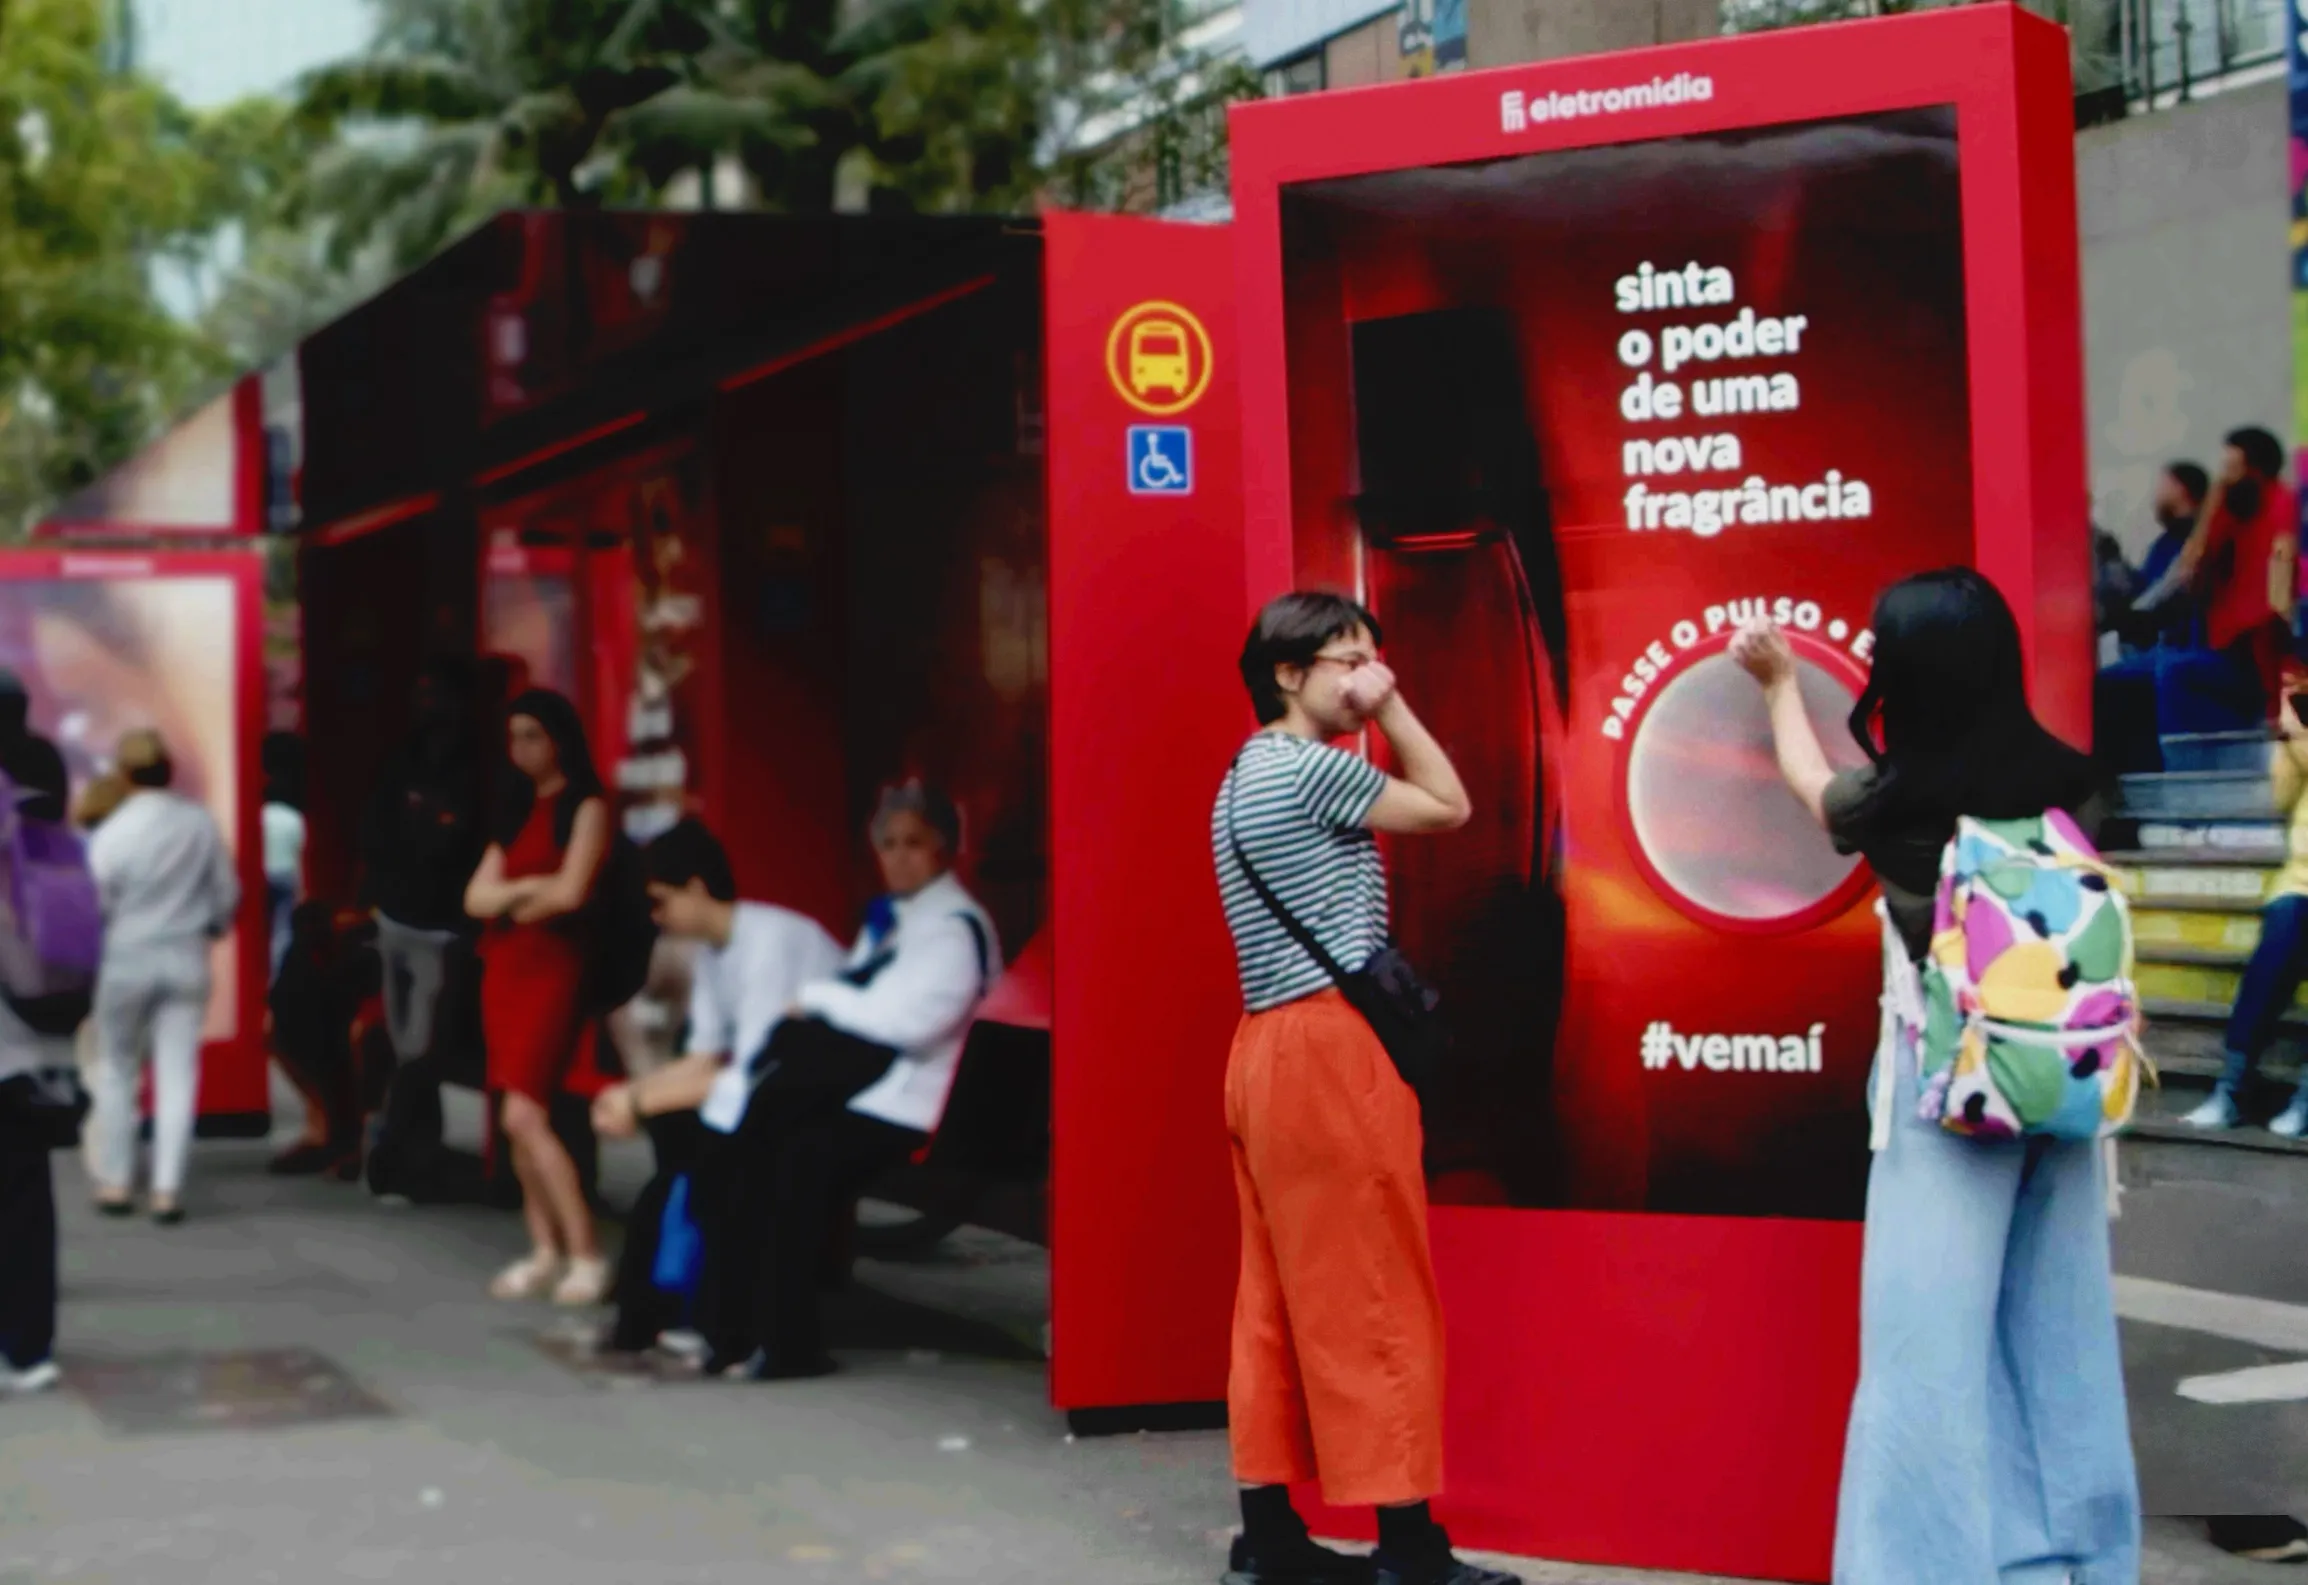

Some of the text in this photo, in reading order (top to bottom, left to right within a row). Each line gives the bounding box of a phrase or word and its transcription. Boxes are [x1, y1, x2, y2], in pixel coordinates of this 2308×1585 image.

[1529, 72, 1713, 122] eletromidia
[1615, 261, 1733, 312] sinta
[1618, 306, 1807, 372] o poder
[1620, 371, 1799, 421] de uma
[1623, 432, 1740, 476] nova
[1624, 469, 1872, 537] fragrância
[1602, 639, 1673, 740] PASSE
[1671, 620, 1698, 648] O
[1640, 1020, 1826, 1073] #vemaí
